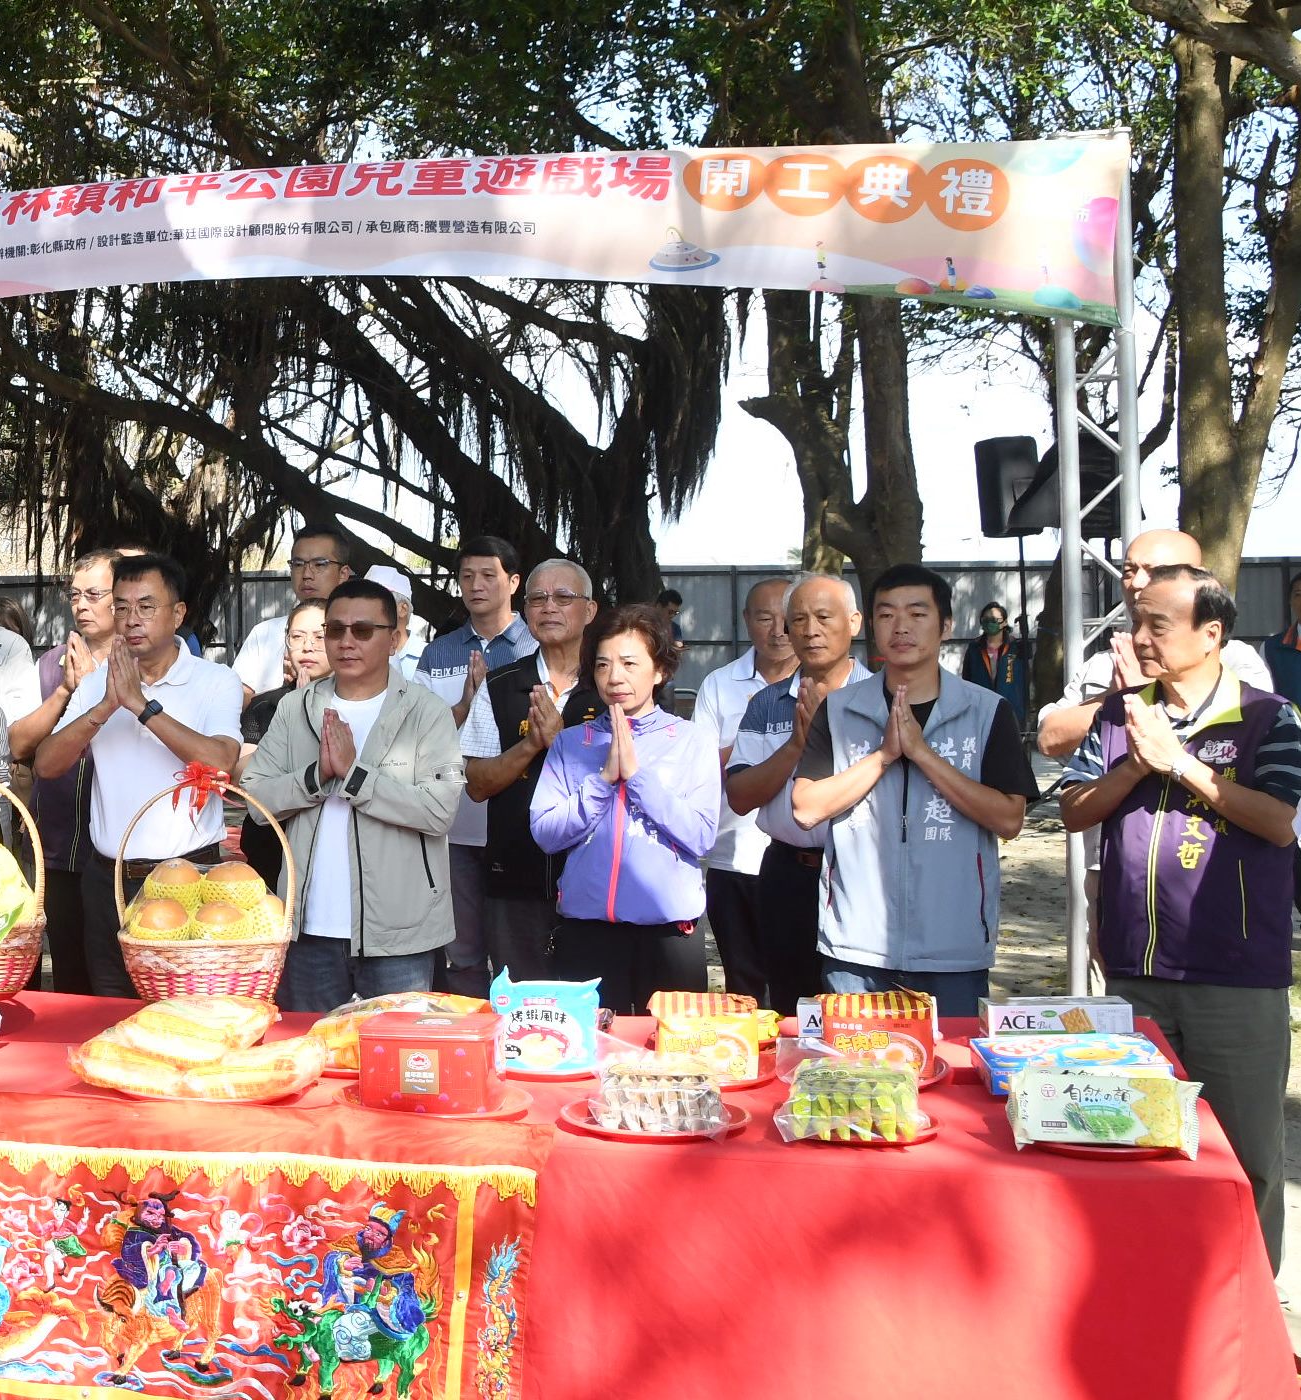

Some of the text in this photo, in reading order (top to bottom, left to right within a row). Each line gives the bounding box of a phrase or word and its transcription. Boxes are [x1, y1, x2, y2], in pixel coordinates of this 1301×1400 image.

[700, 159, 993, 217] 開工典禮
[431, 667, 451, 678] FELIX
[959, 737, 977, 770] 議員
[923, 737, 958, 824] 洪超
[925, 826, 953, 841] 團隊
[806, 1014, 822, 1028] A
[999, 1015, 1036, 1030] ACE
